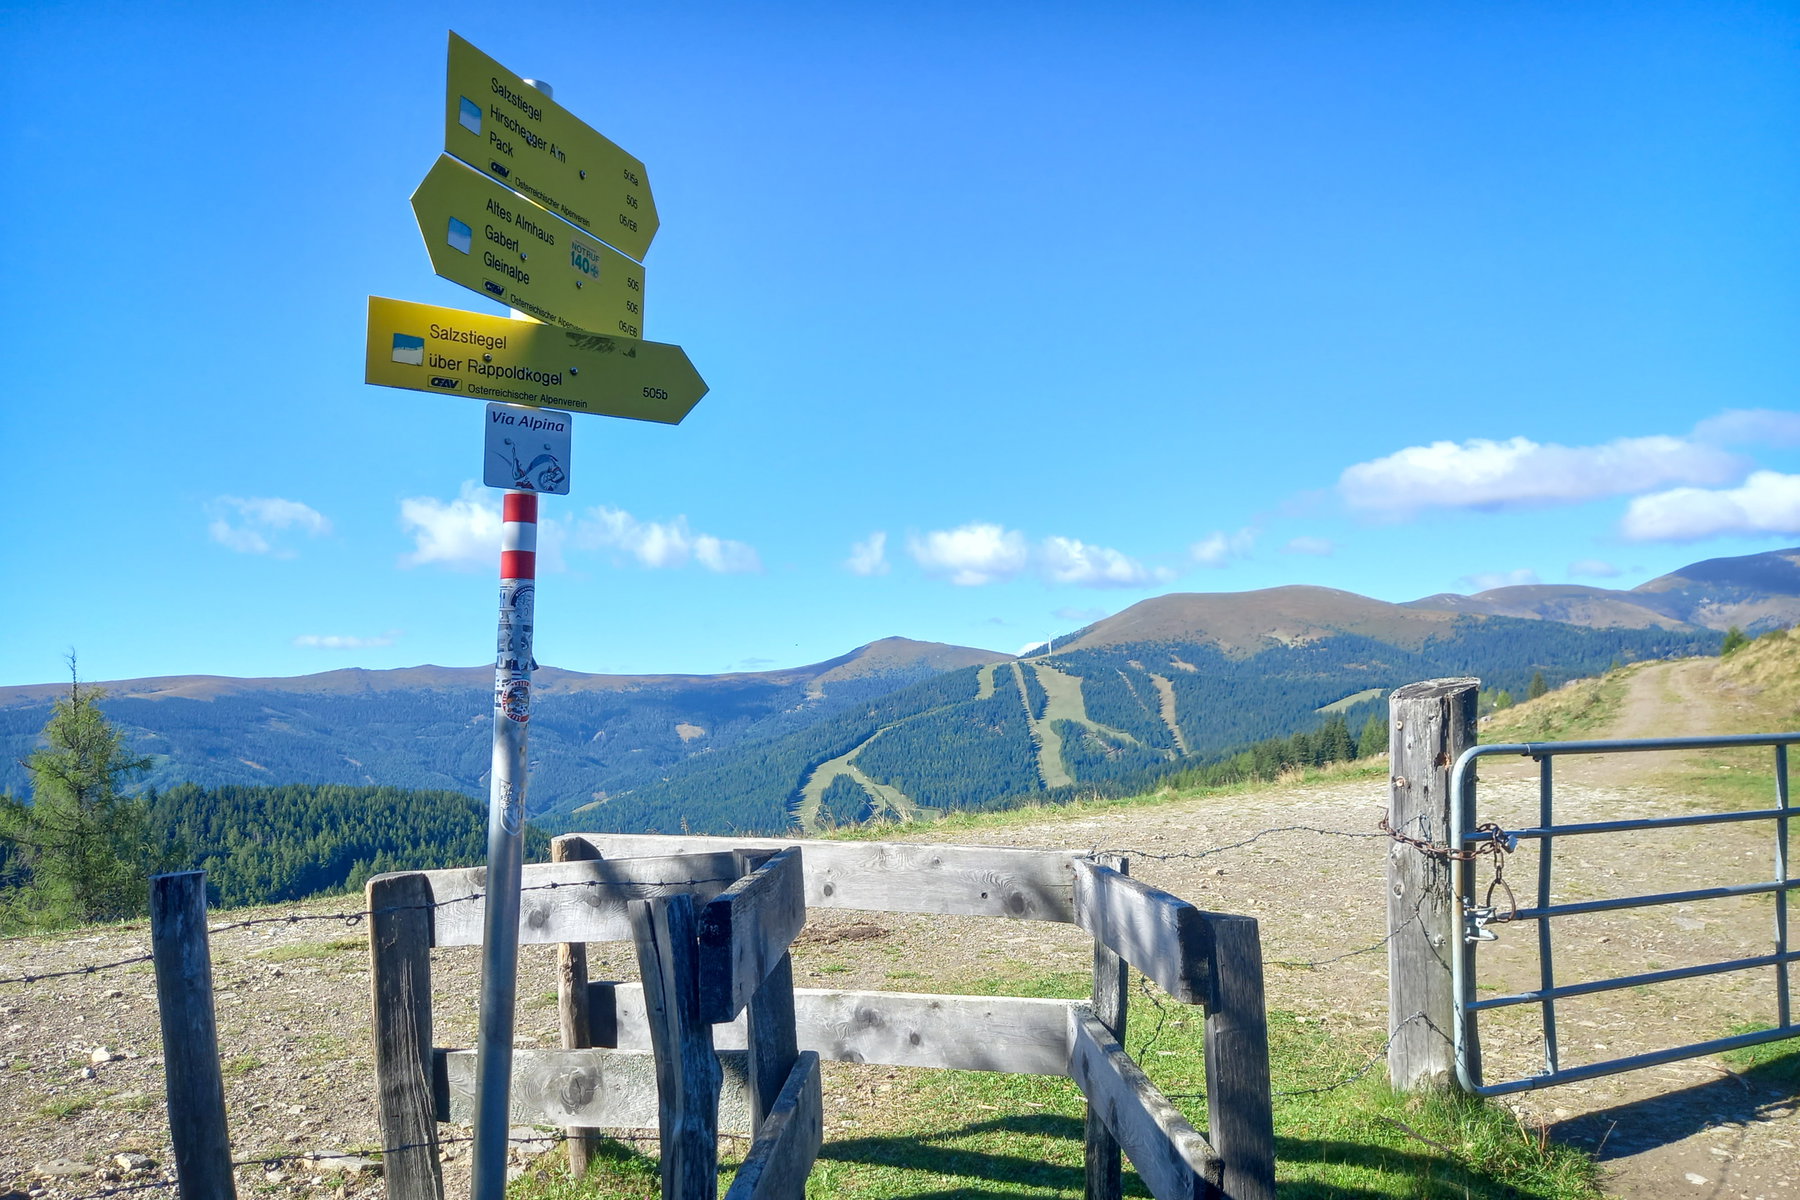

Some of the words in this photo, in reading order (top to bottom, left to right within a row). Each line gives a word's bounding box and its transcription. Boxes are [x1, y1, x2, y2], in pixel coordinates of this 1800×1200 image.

[491, 77, 542, 122] Salzstiegel
[489, 131, 514, 158] Pack
[550, 143, 566, 164] Am
[626, 194, 638, 210] 505
[486, 198, 512, 223] Altes
[515, 214, 555, 246] Almhaus
[485, 224, 519, 253] Gaberl
[571, 241, 600, 264] NOTRUF
[571, 250, 590, 274] 140
[483, 251, 530, 285] Gleinalpe
[627, 277, 640, 292] 505
[626, 300, 639, 315] 505
[430, 324, 507, 350] Salzstiegel
[429, 353, 463, 371] über
[468, 358, 563, 387] Rappoldkogel
[540, 392, 588, 409] Alpenverein
[642, 386, 669, 400] 505b
[491, 411, 515, 426] Via
[518, 415, 565, 432] Alpina
